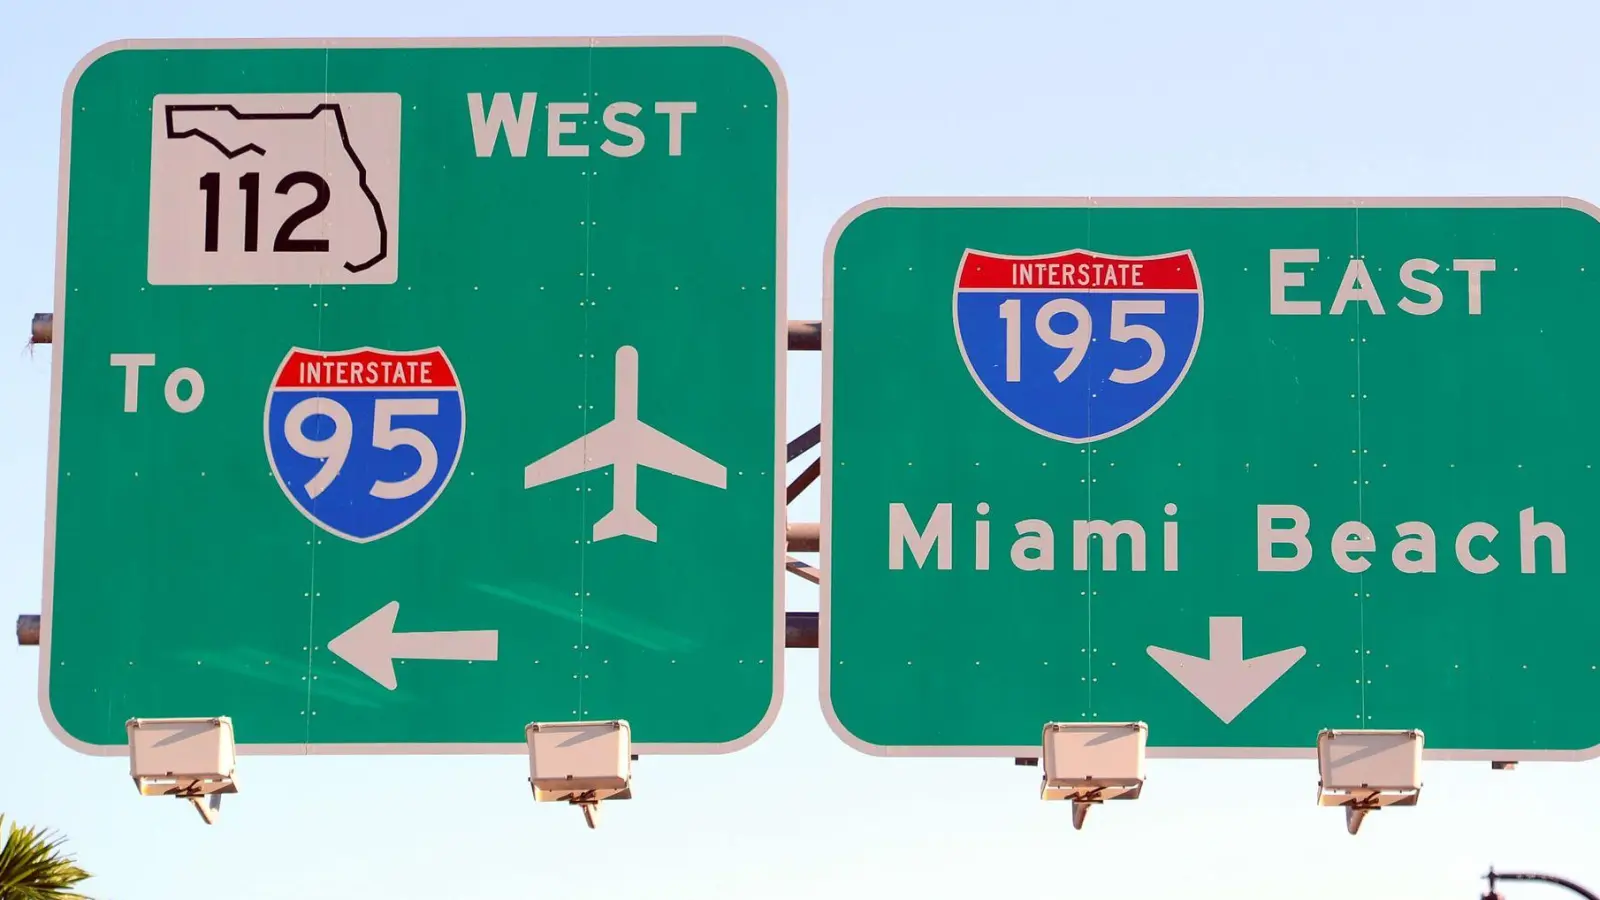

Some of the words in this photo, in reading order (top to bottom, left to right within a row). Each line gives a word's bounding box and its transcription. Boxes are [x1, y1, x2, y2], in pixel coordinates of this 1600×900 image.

[467, 92, 697, 158] WEST
[199, 170, 331, 253] 112
[1011, 262, 1144, 287] INTERSTATE
[1269, 248, 1496, 316] EAST
[298, 361, 433, 385] INTERSTATE
[999, 298, 1166, 384] 195
[284, 397, 440, 500] 95
[888, 502, 1179, 572] Miami
[1257, 504, 1567, 574] Beach
